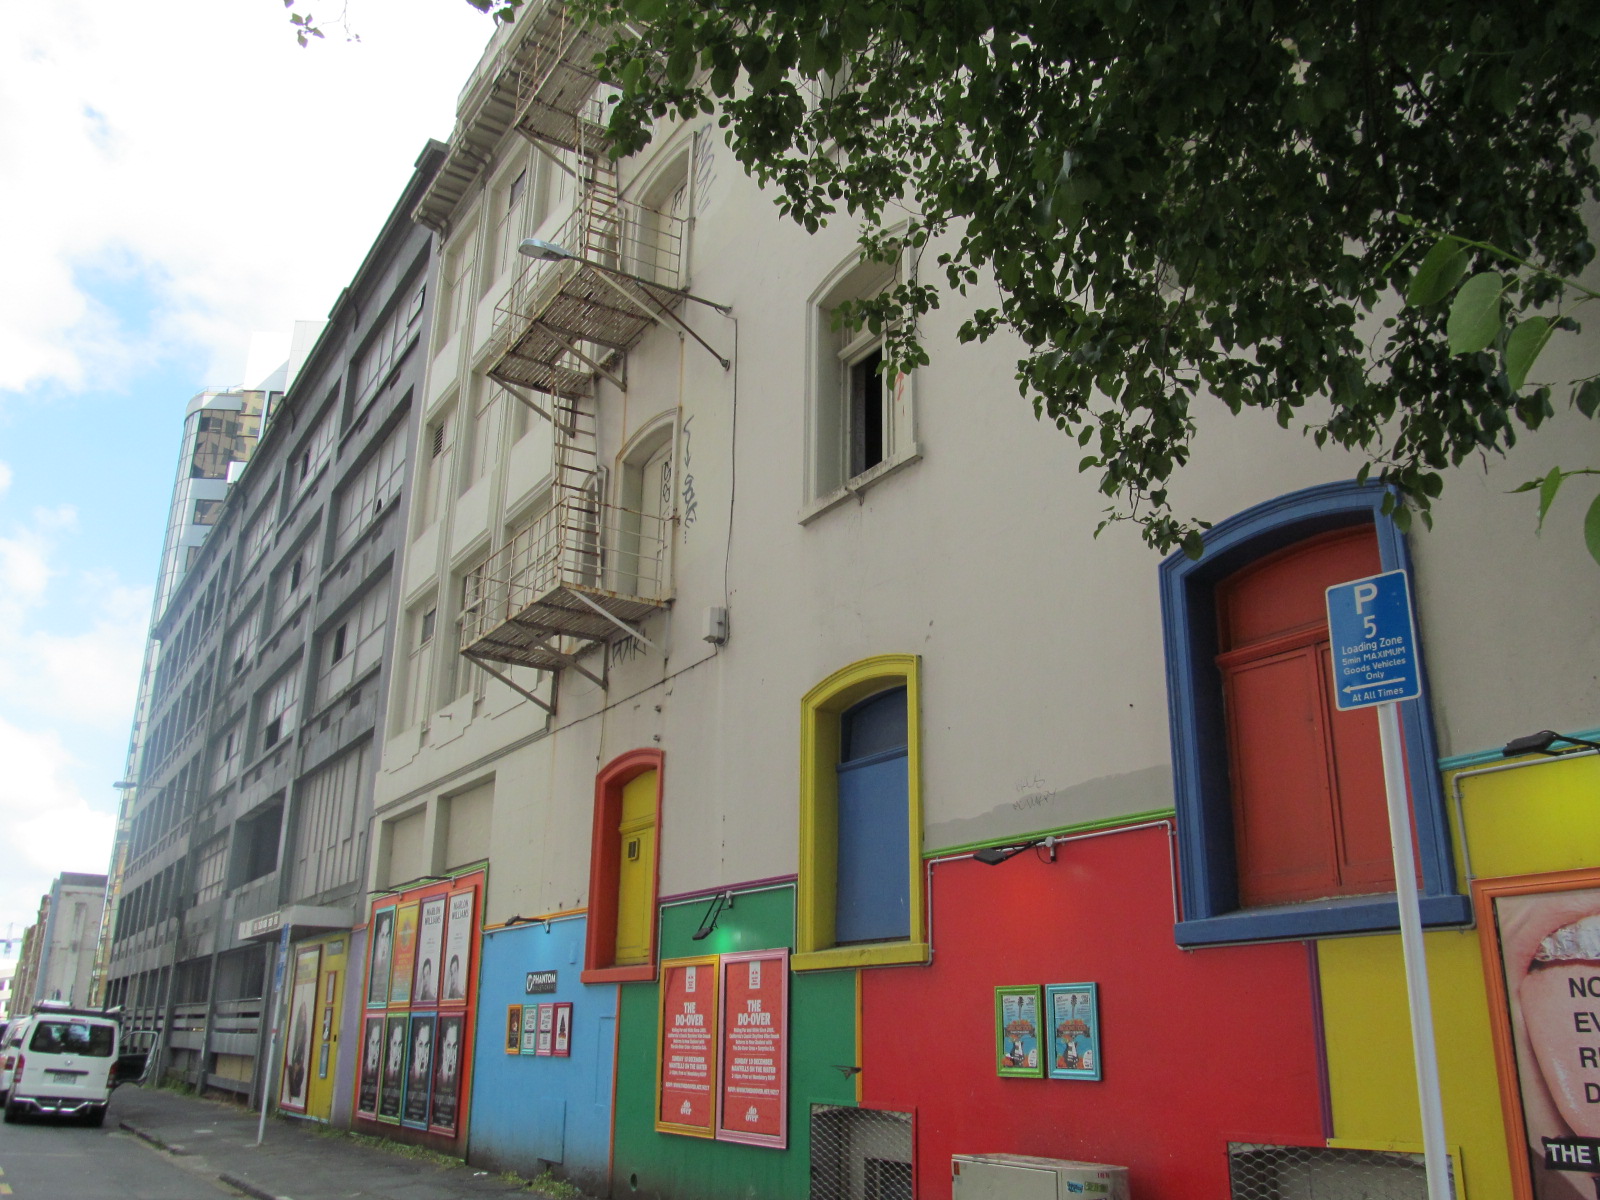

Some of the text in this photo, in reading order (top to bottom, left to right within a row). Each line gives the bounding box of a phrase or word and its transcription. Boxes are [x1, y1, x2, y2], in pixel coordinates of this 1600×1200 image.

[1354, 583, 1378, 615] P
[1363, 615, 1377, 639] 5
[1342, 636, 1403, 655] Loading Zone
[1342, 646, 1406, 666] 5min MAXIMUM
[1344, 658, 1406, 675] Goods Vehicles
[1366, 671, 1385, 680] Only
[1352, 687, 1404, 702] At All Times
[532, 973, 556, 984] PHANTOM
[683, 1002, 696, 1013] THE
[747, 1000, 762, 1012] THE
[675, 1014, 704, 1026] DO-OVER
[738, 1012, 771, 1026] DO-OVER
[1546, 1143, 1592, 1164] THE
